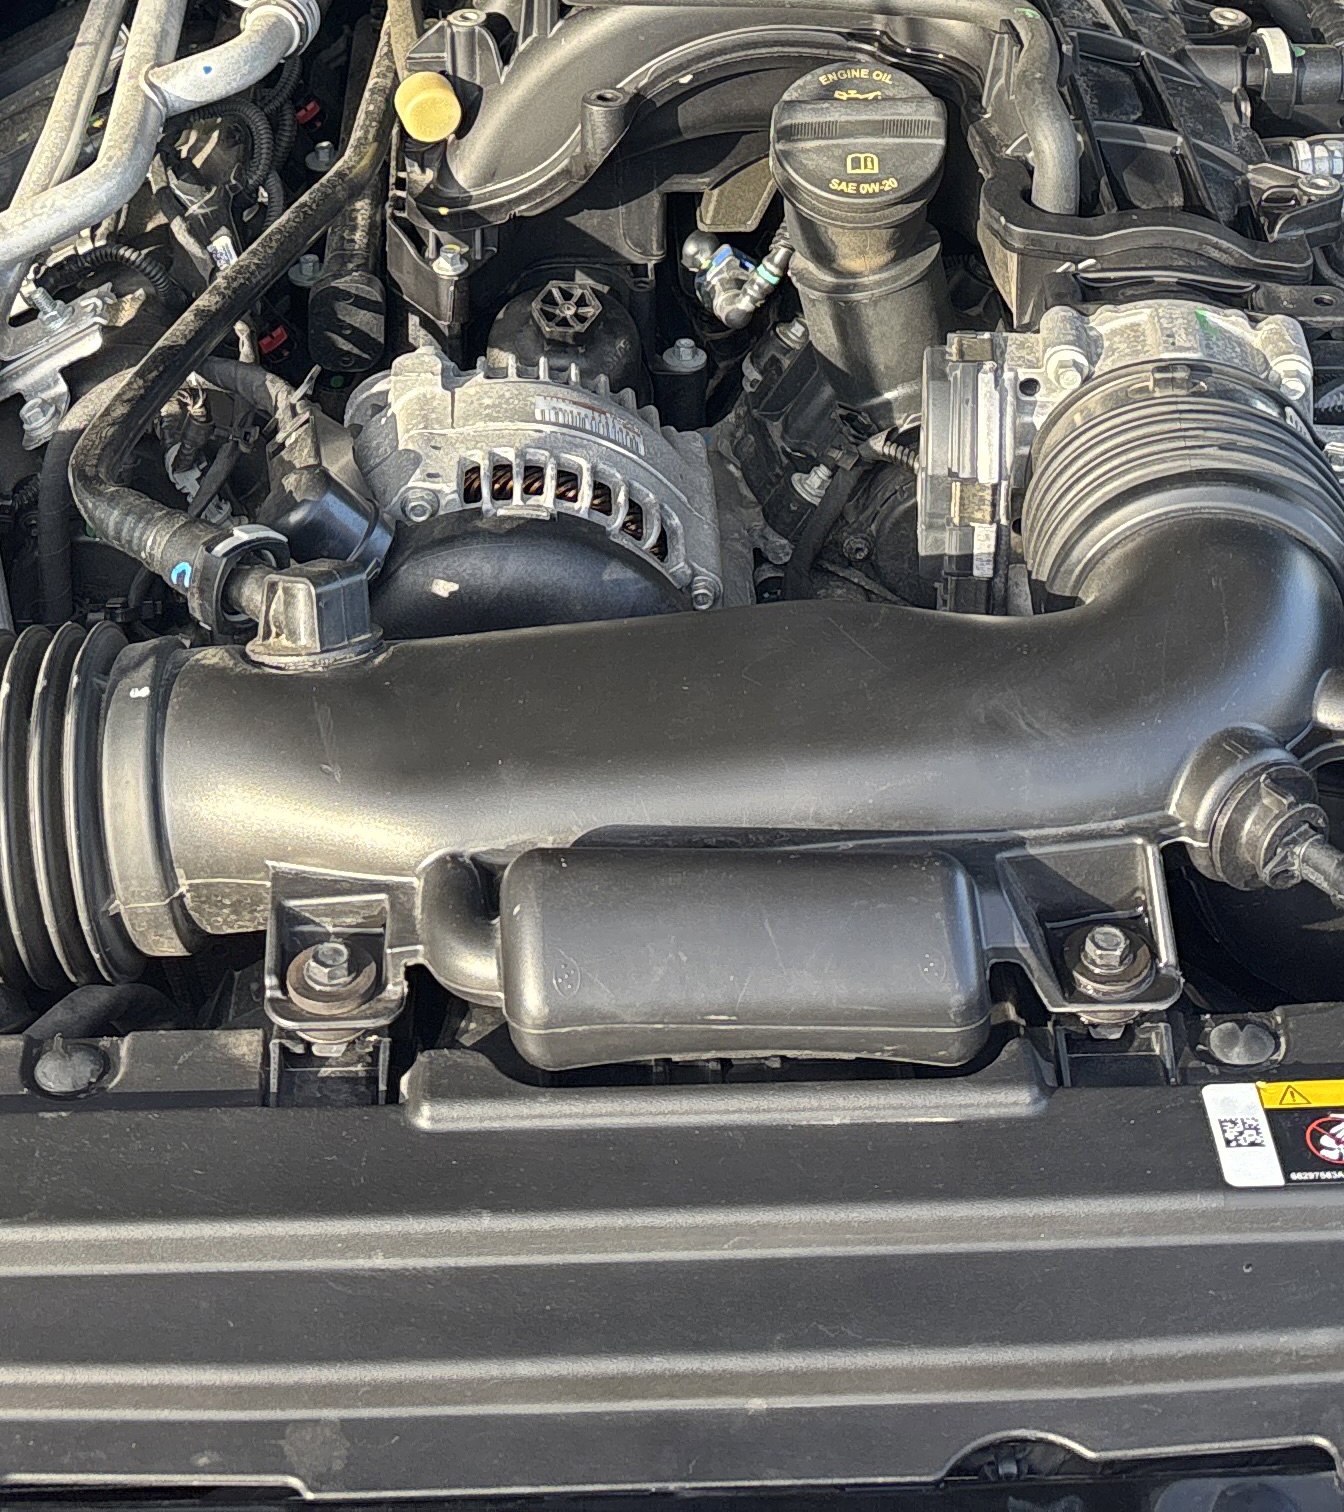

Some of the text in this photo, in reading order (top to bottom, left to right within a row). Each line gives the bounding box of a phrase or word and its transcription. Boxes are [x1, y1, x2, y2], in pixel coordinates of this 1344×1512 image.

[818, 68, 893, 86] ENGINE OIL
[828, 177, 899, 195] SAE 0W-20
